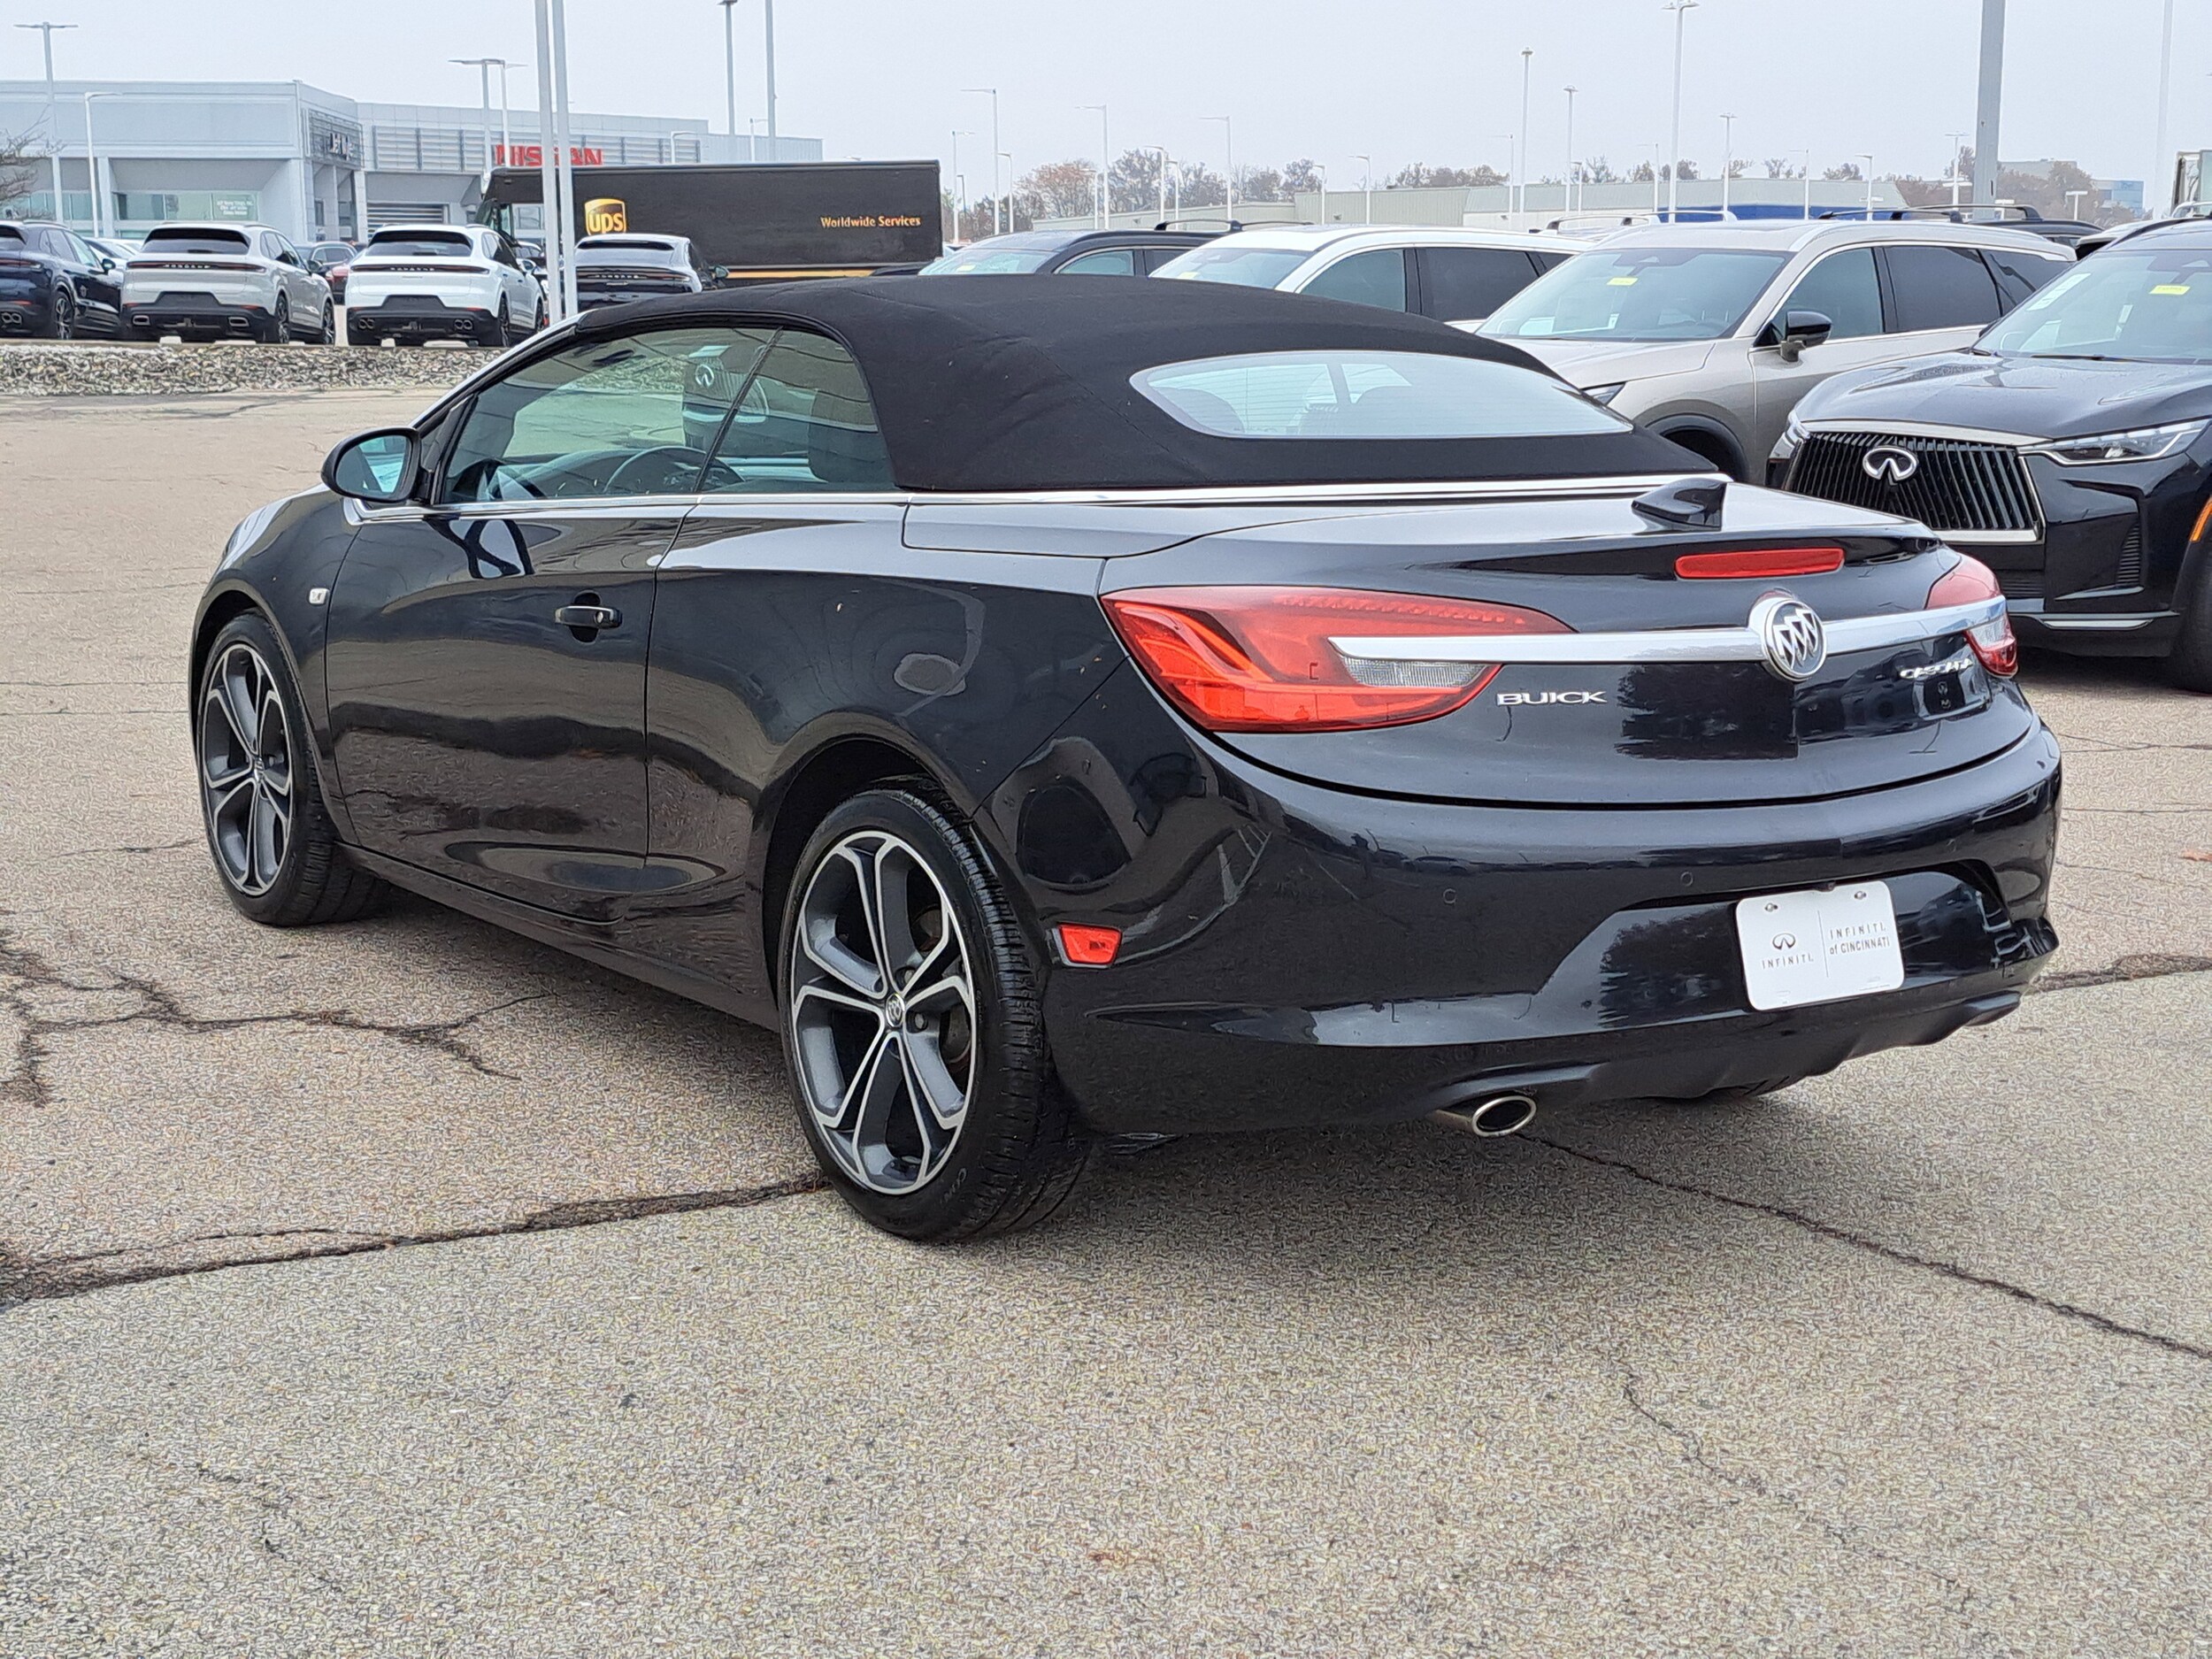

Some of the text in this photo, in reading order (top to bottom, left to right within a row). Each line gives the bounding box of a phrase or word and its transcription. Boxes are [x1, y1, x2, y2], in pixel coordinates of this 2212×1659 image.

[495, 144, 603, 166] NISAN
[820, 215, 921, 228] Worldwide Services
[1496, 690, 1609, 706] BUICK
[1829, 935, 1891, 956] of CINCINNATI
